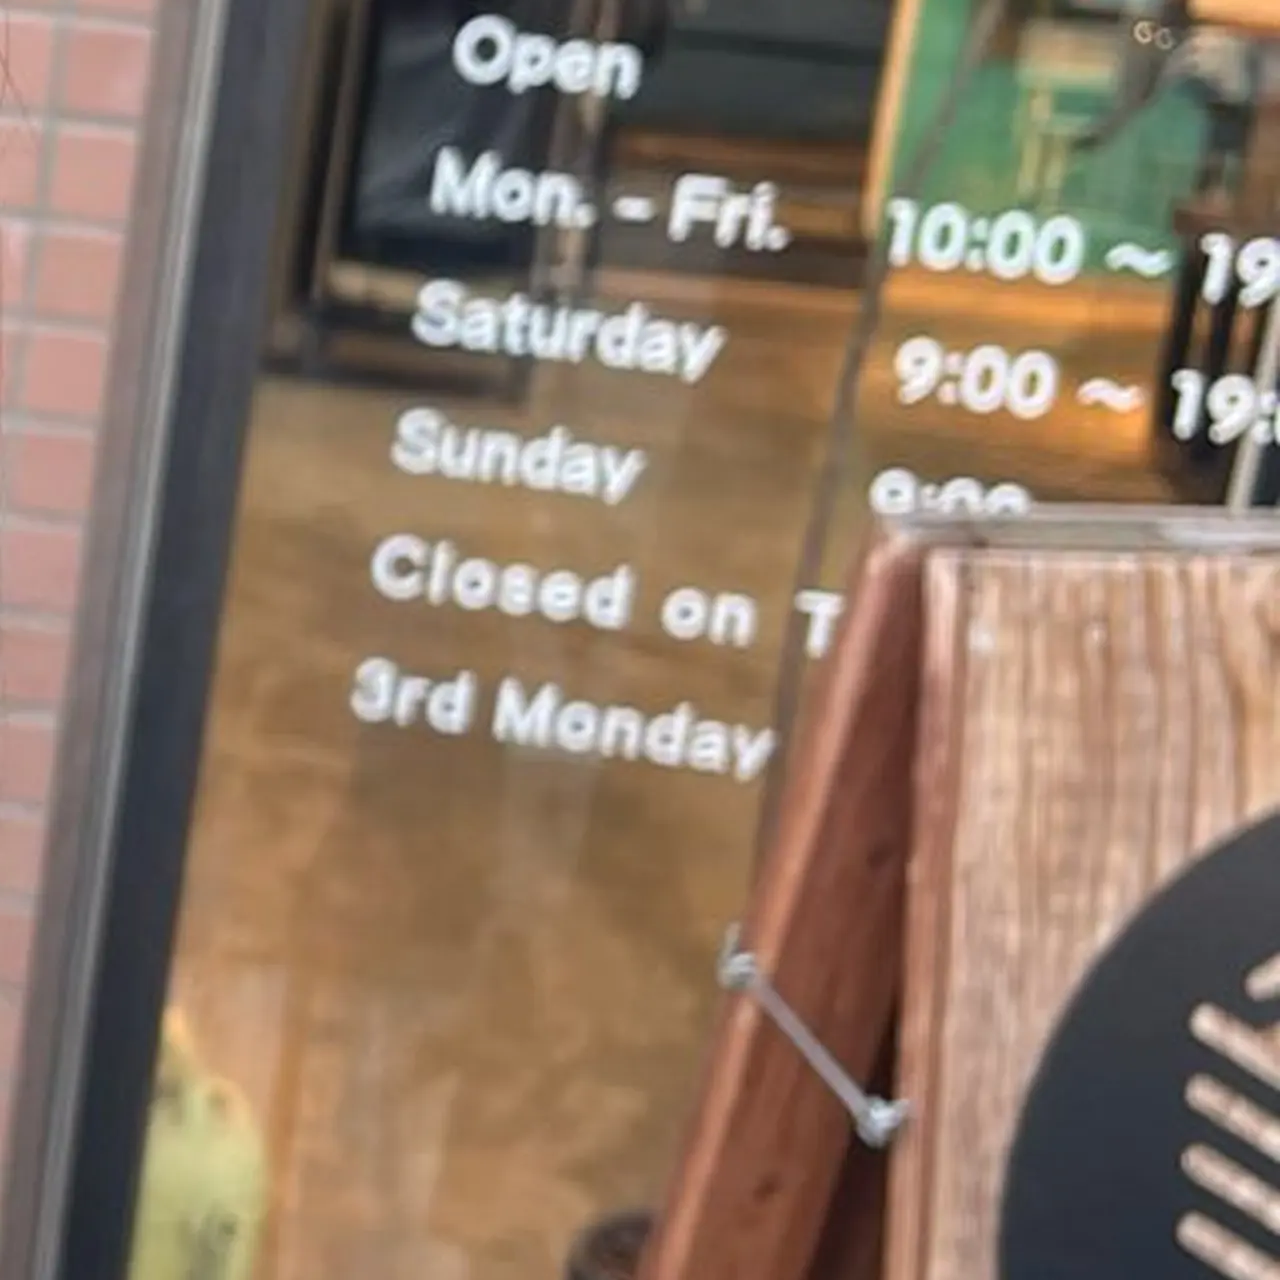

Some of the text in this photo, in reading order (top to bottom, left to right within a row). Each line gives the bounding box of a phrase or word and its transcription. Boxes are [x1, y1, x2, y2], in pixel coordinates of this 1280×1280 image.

[453, 14, 641, 99] Open
[430, 149, 595, 228] Mon.
[668, 173, 790, 252] Fri.
[887, 199, 1084, 285] 10:00
[411, 278, 726, 384] Saturday
[894, 336, 1058, 419] 9:00
[1171, 368, 1280, 445] 19:
[391, 407, 646, 504] Sunday
[371, 533, 632, 631] Closed
[662, 584, 756, 648] on
[350, 657, 776, 781] 3rd Monday
